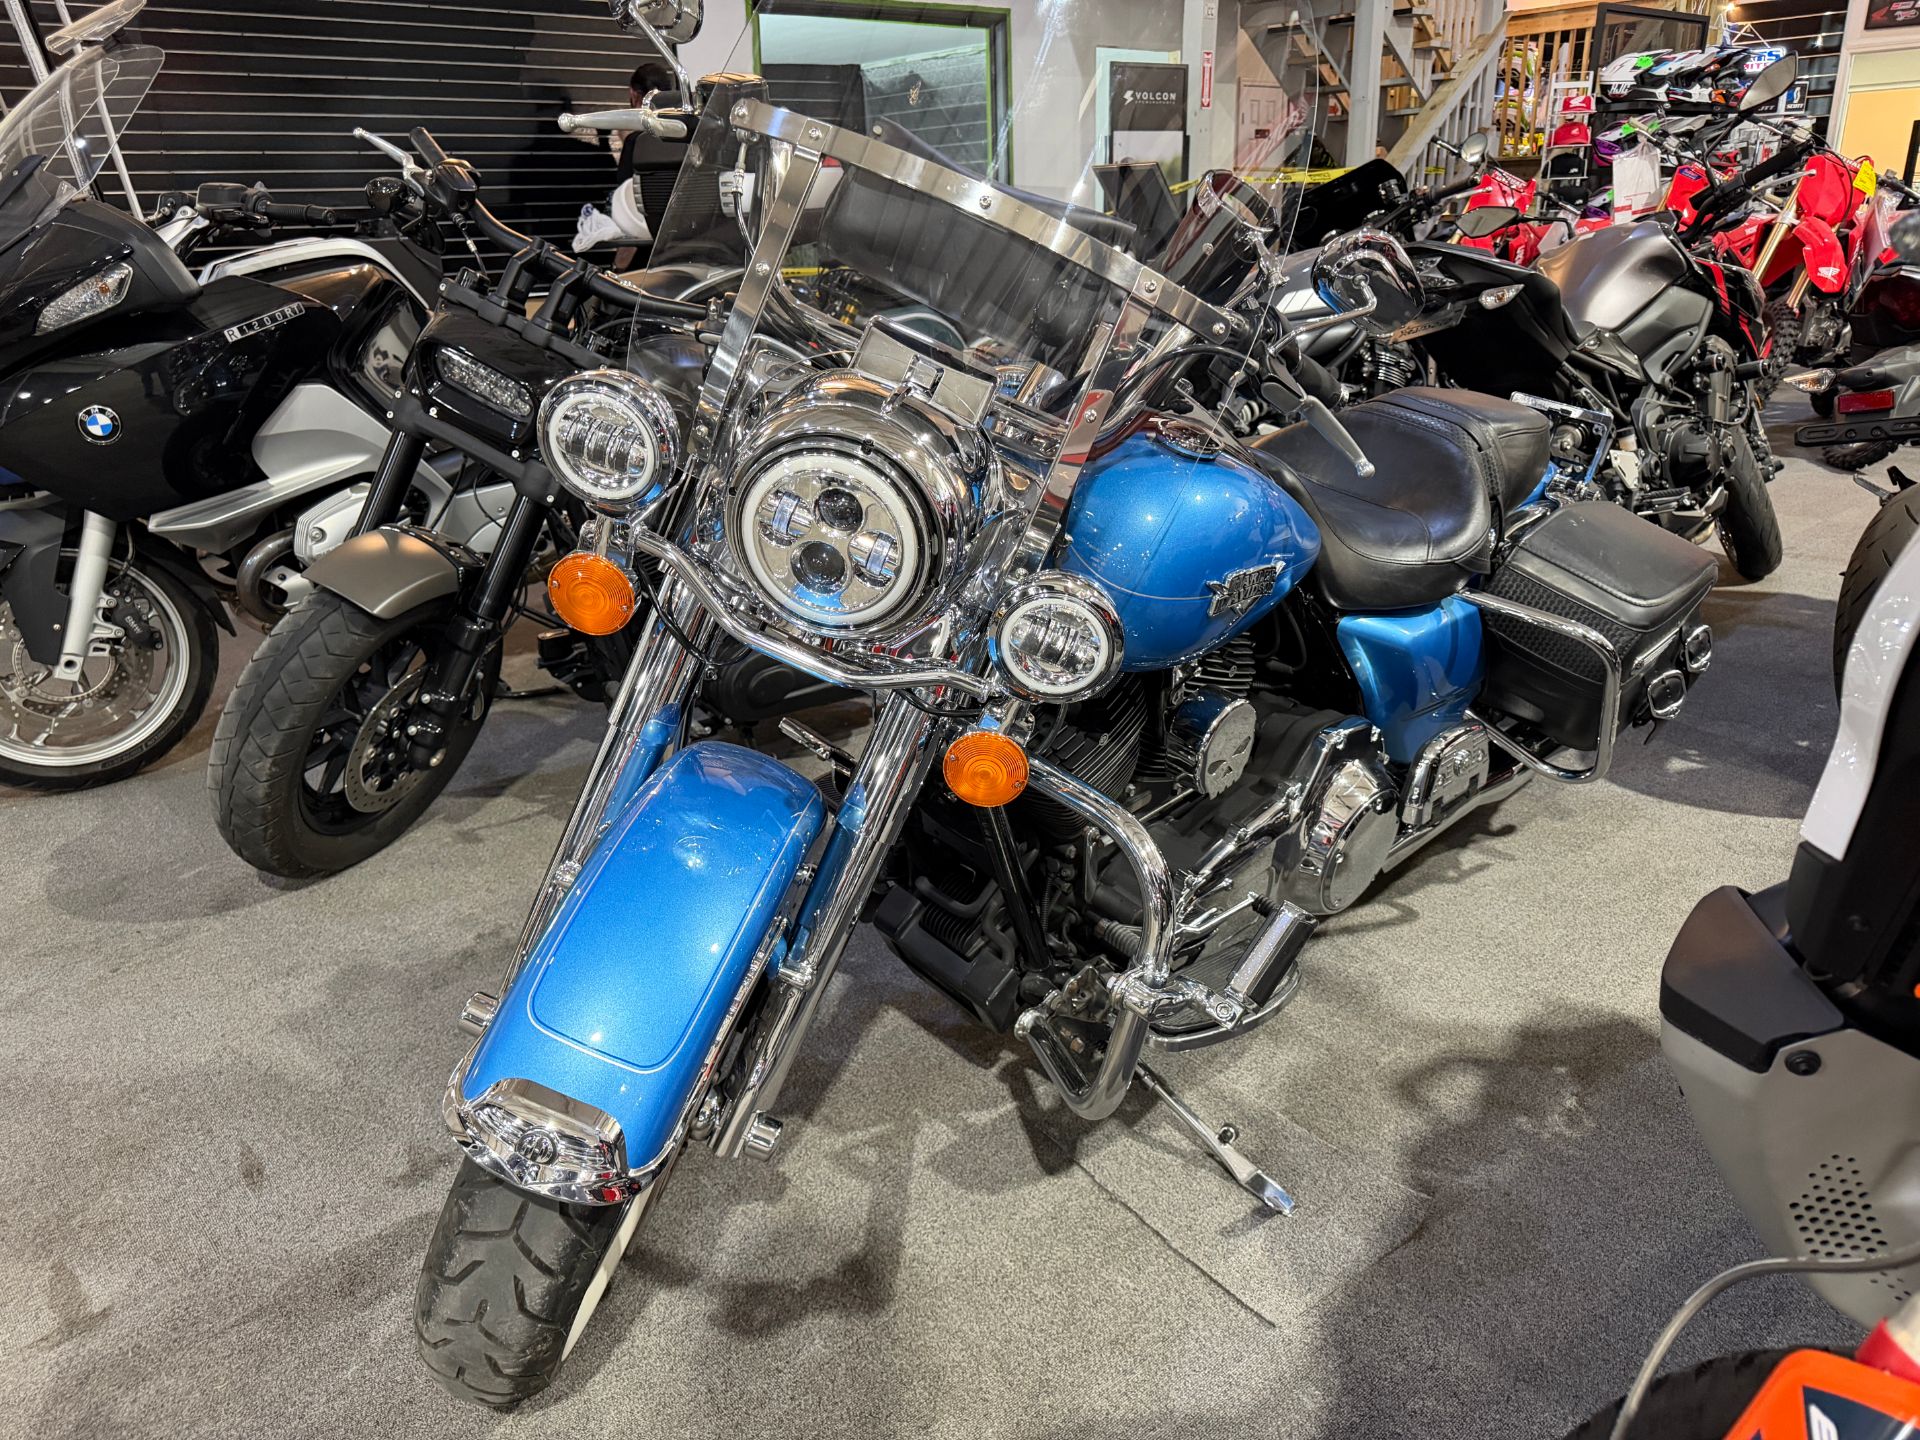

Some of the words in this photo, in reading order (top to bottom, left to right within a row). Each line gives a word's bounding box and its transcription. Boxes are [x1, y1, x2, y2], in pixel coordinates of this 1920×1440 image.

[1135, 92, 1177, 101] VOLCON
[81, 407, 115, 422] BMW
[125, 615, 142, 634] BMW
